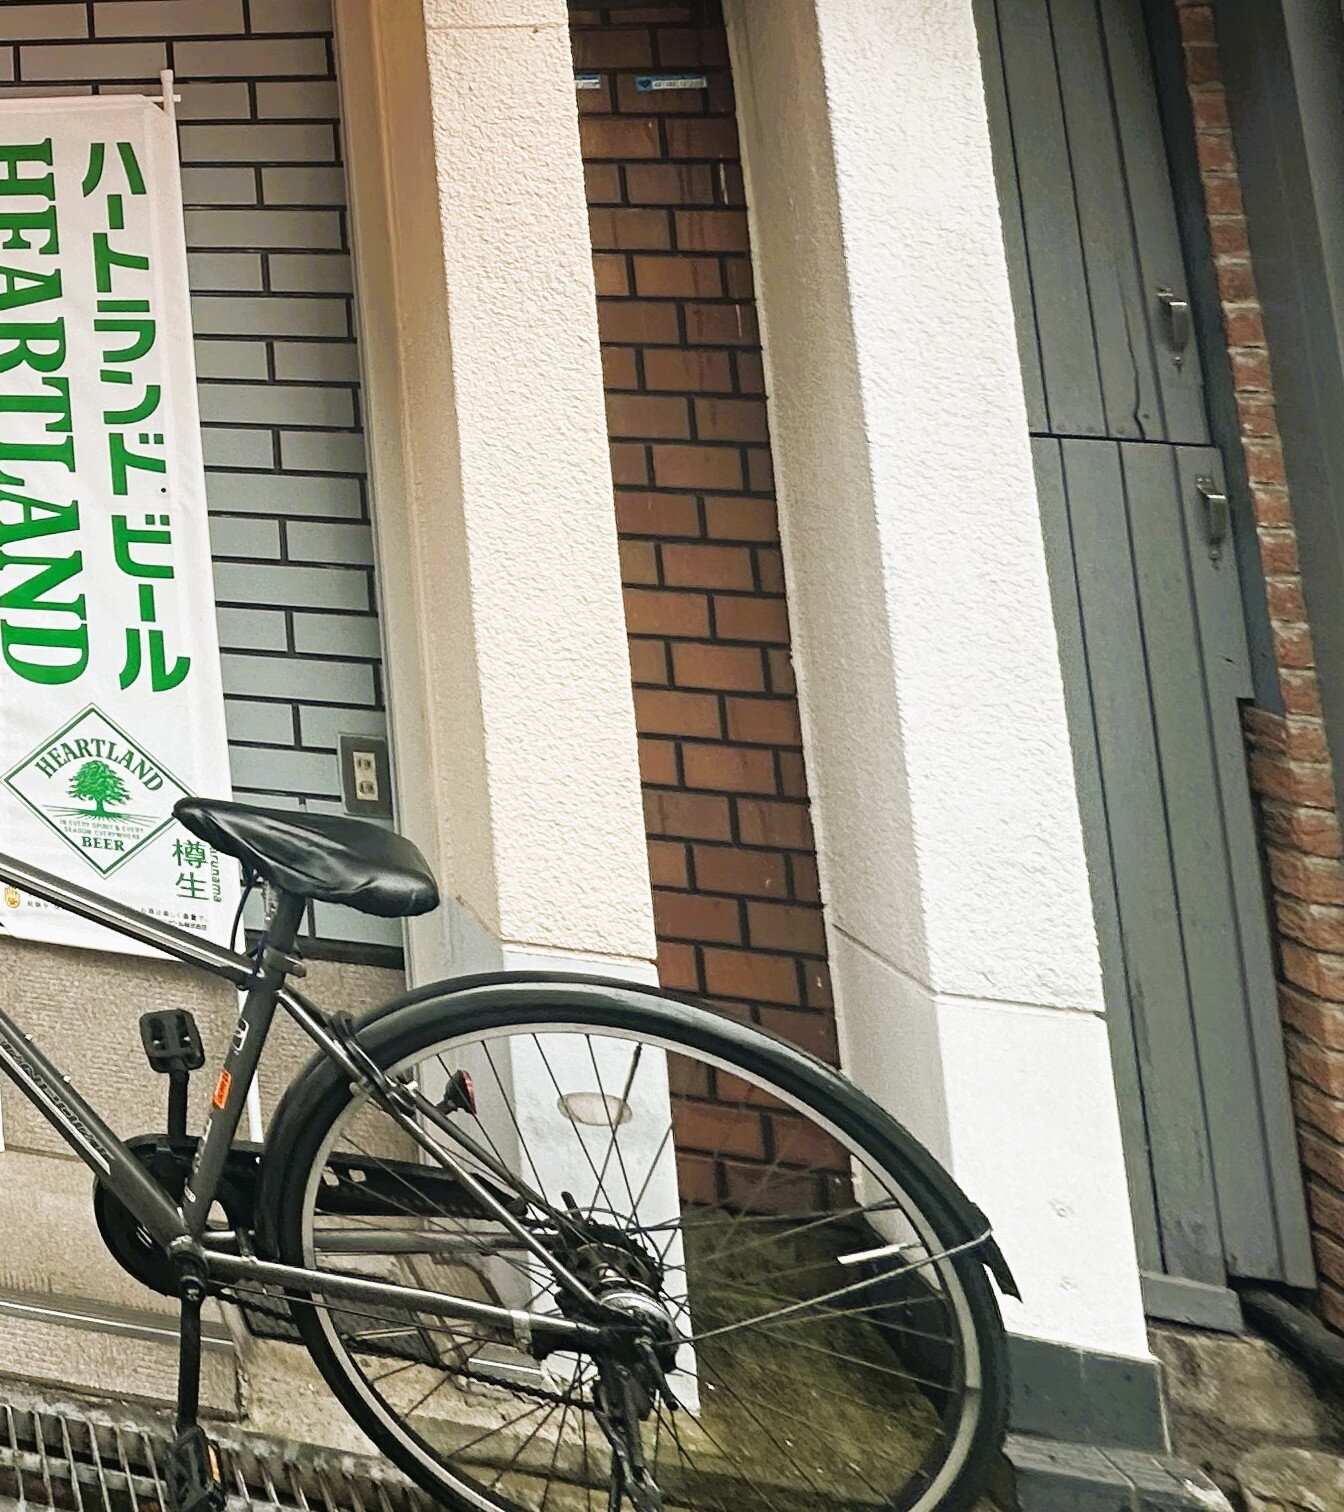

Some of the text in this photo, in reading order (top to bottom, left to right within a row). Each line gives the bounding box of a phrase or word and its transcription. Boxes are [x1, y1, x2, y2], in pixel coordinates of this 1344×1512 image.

[81, 141, 192, 694] ハートランドビール
[33, 737, 164, 792] HEARTLAND
[82, 836, 125, 852] BEER
[171, 838, 210, 901] 樽生
